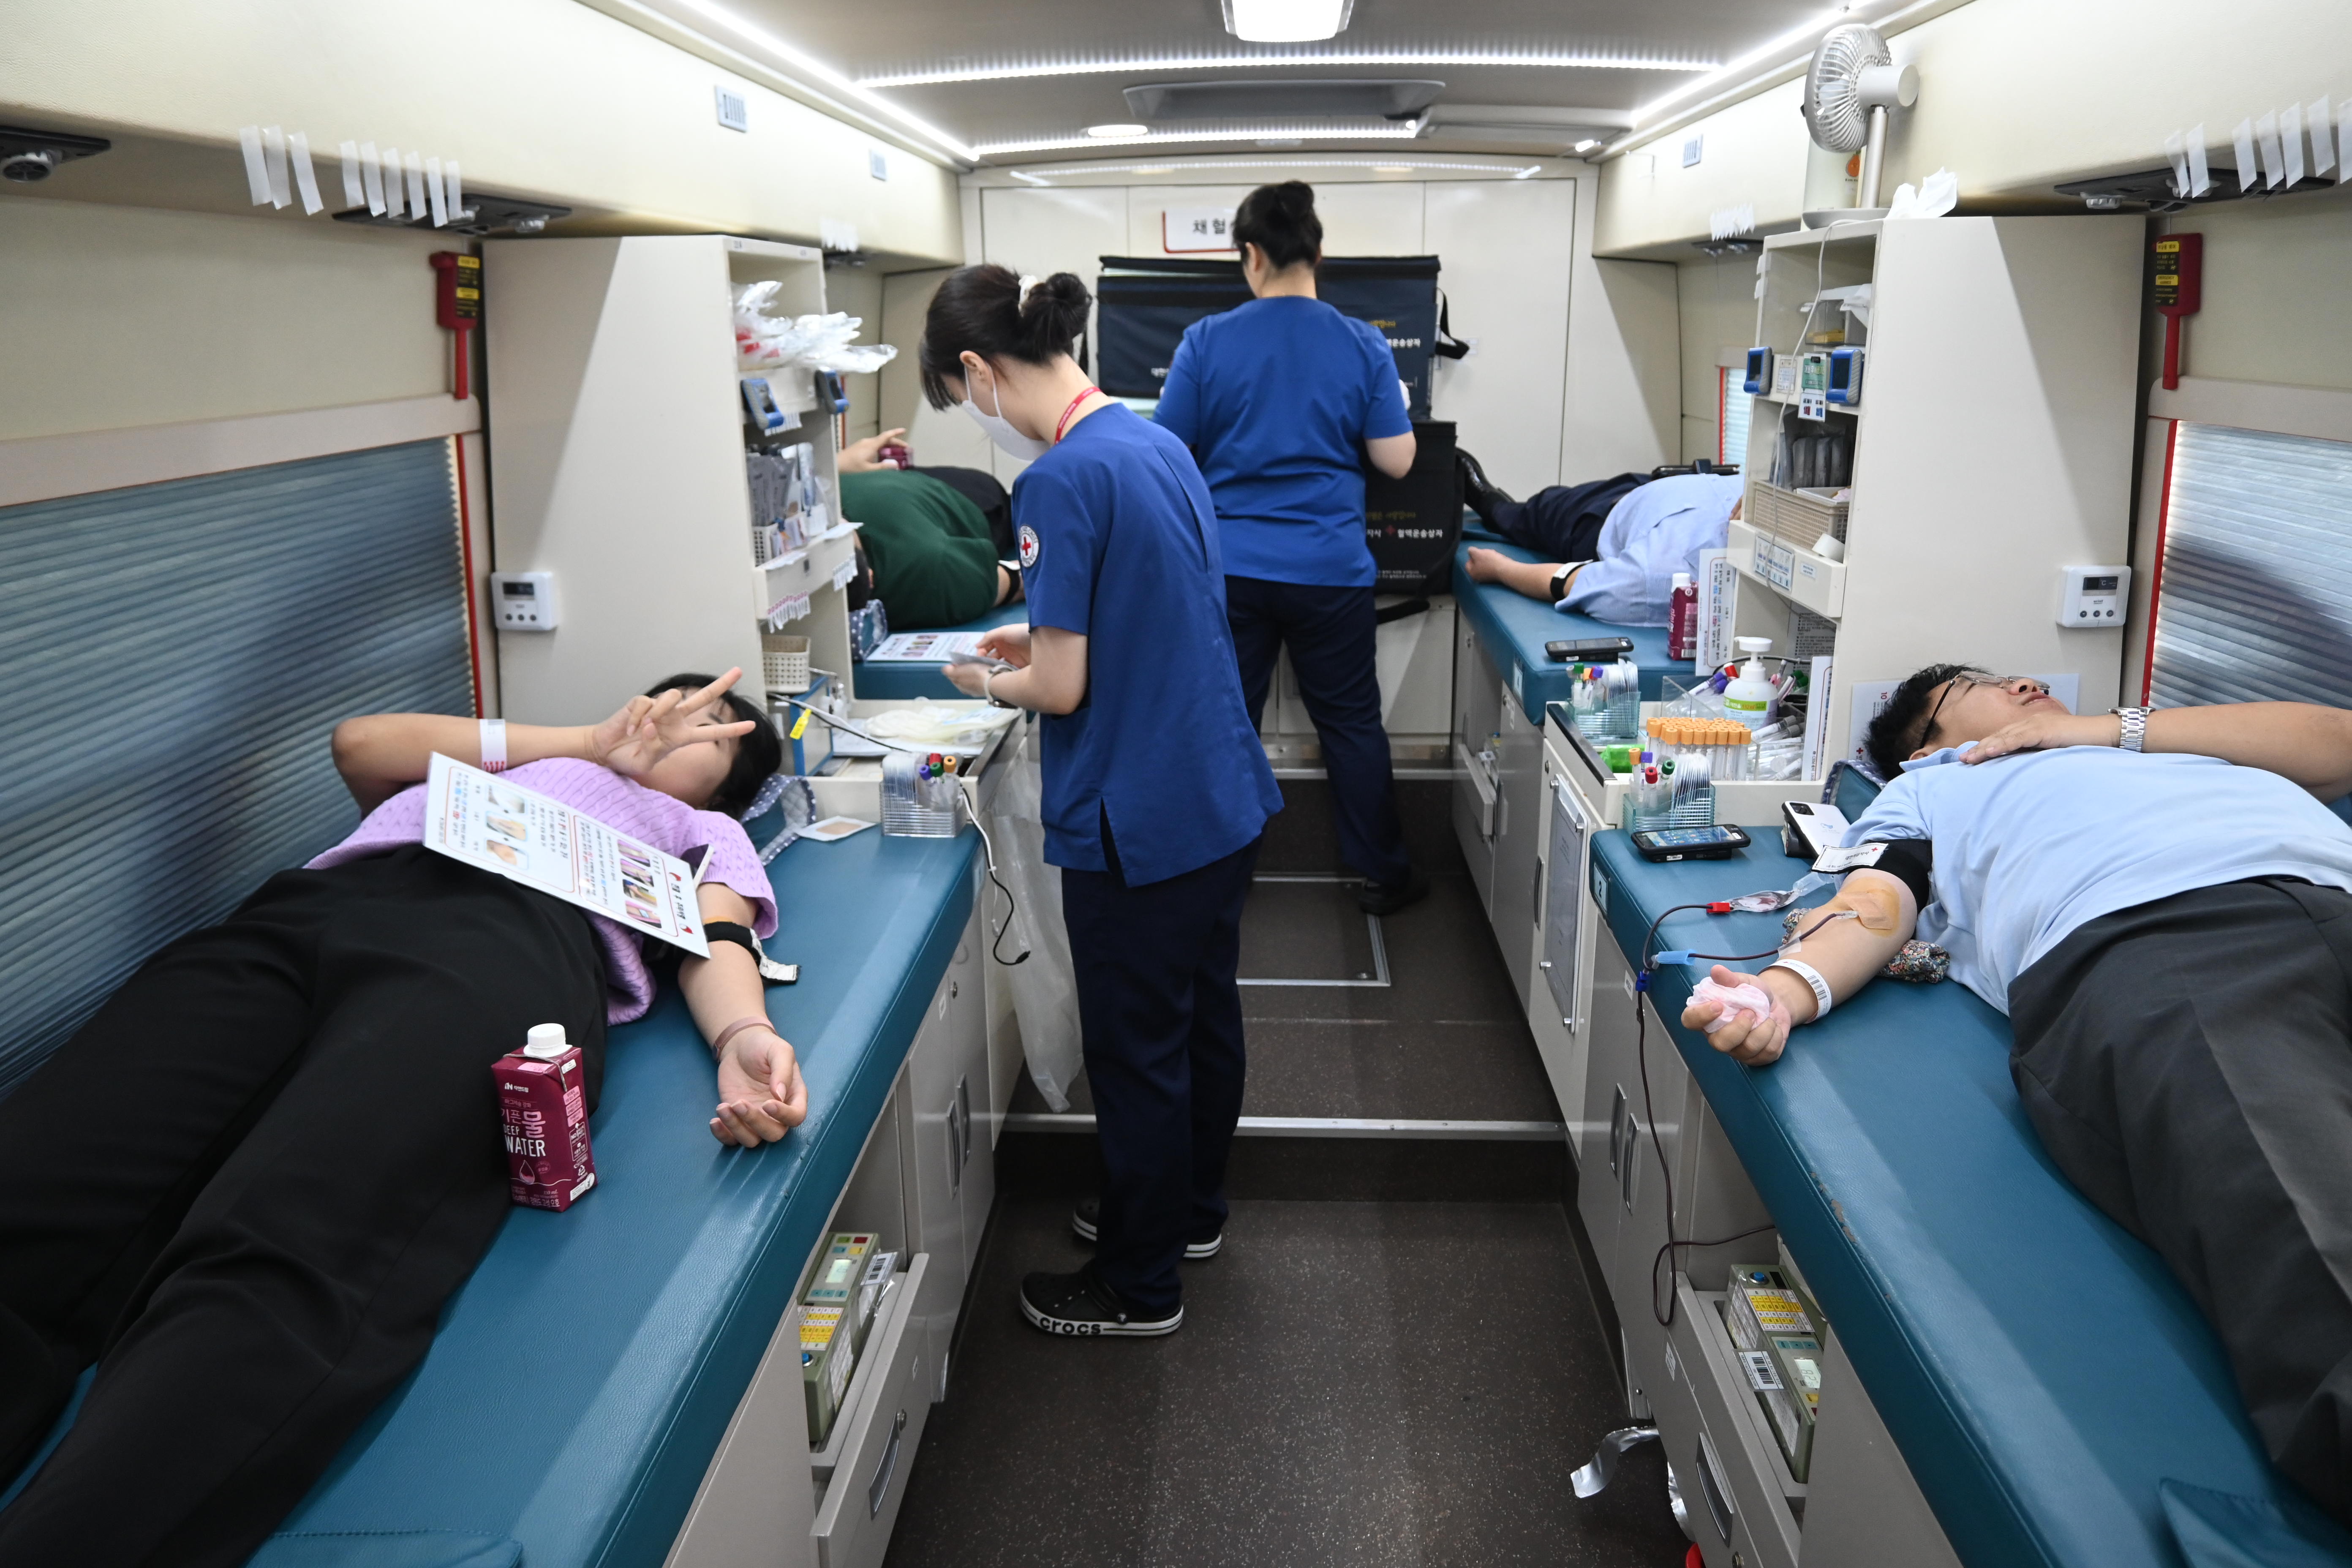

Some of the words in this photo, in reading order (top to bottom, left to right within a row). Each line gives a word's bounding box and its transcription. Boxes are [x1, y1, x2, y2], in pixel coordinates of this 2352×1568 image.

[1881, 691, 1887, 700] 10
[503, 1124, 520, 1135] DEEP
[505, 1135, 546, 1157] WATER
[1039, 1317, 1101, 1335] crocs
